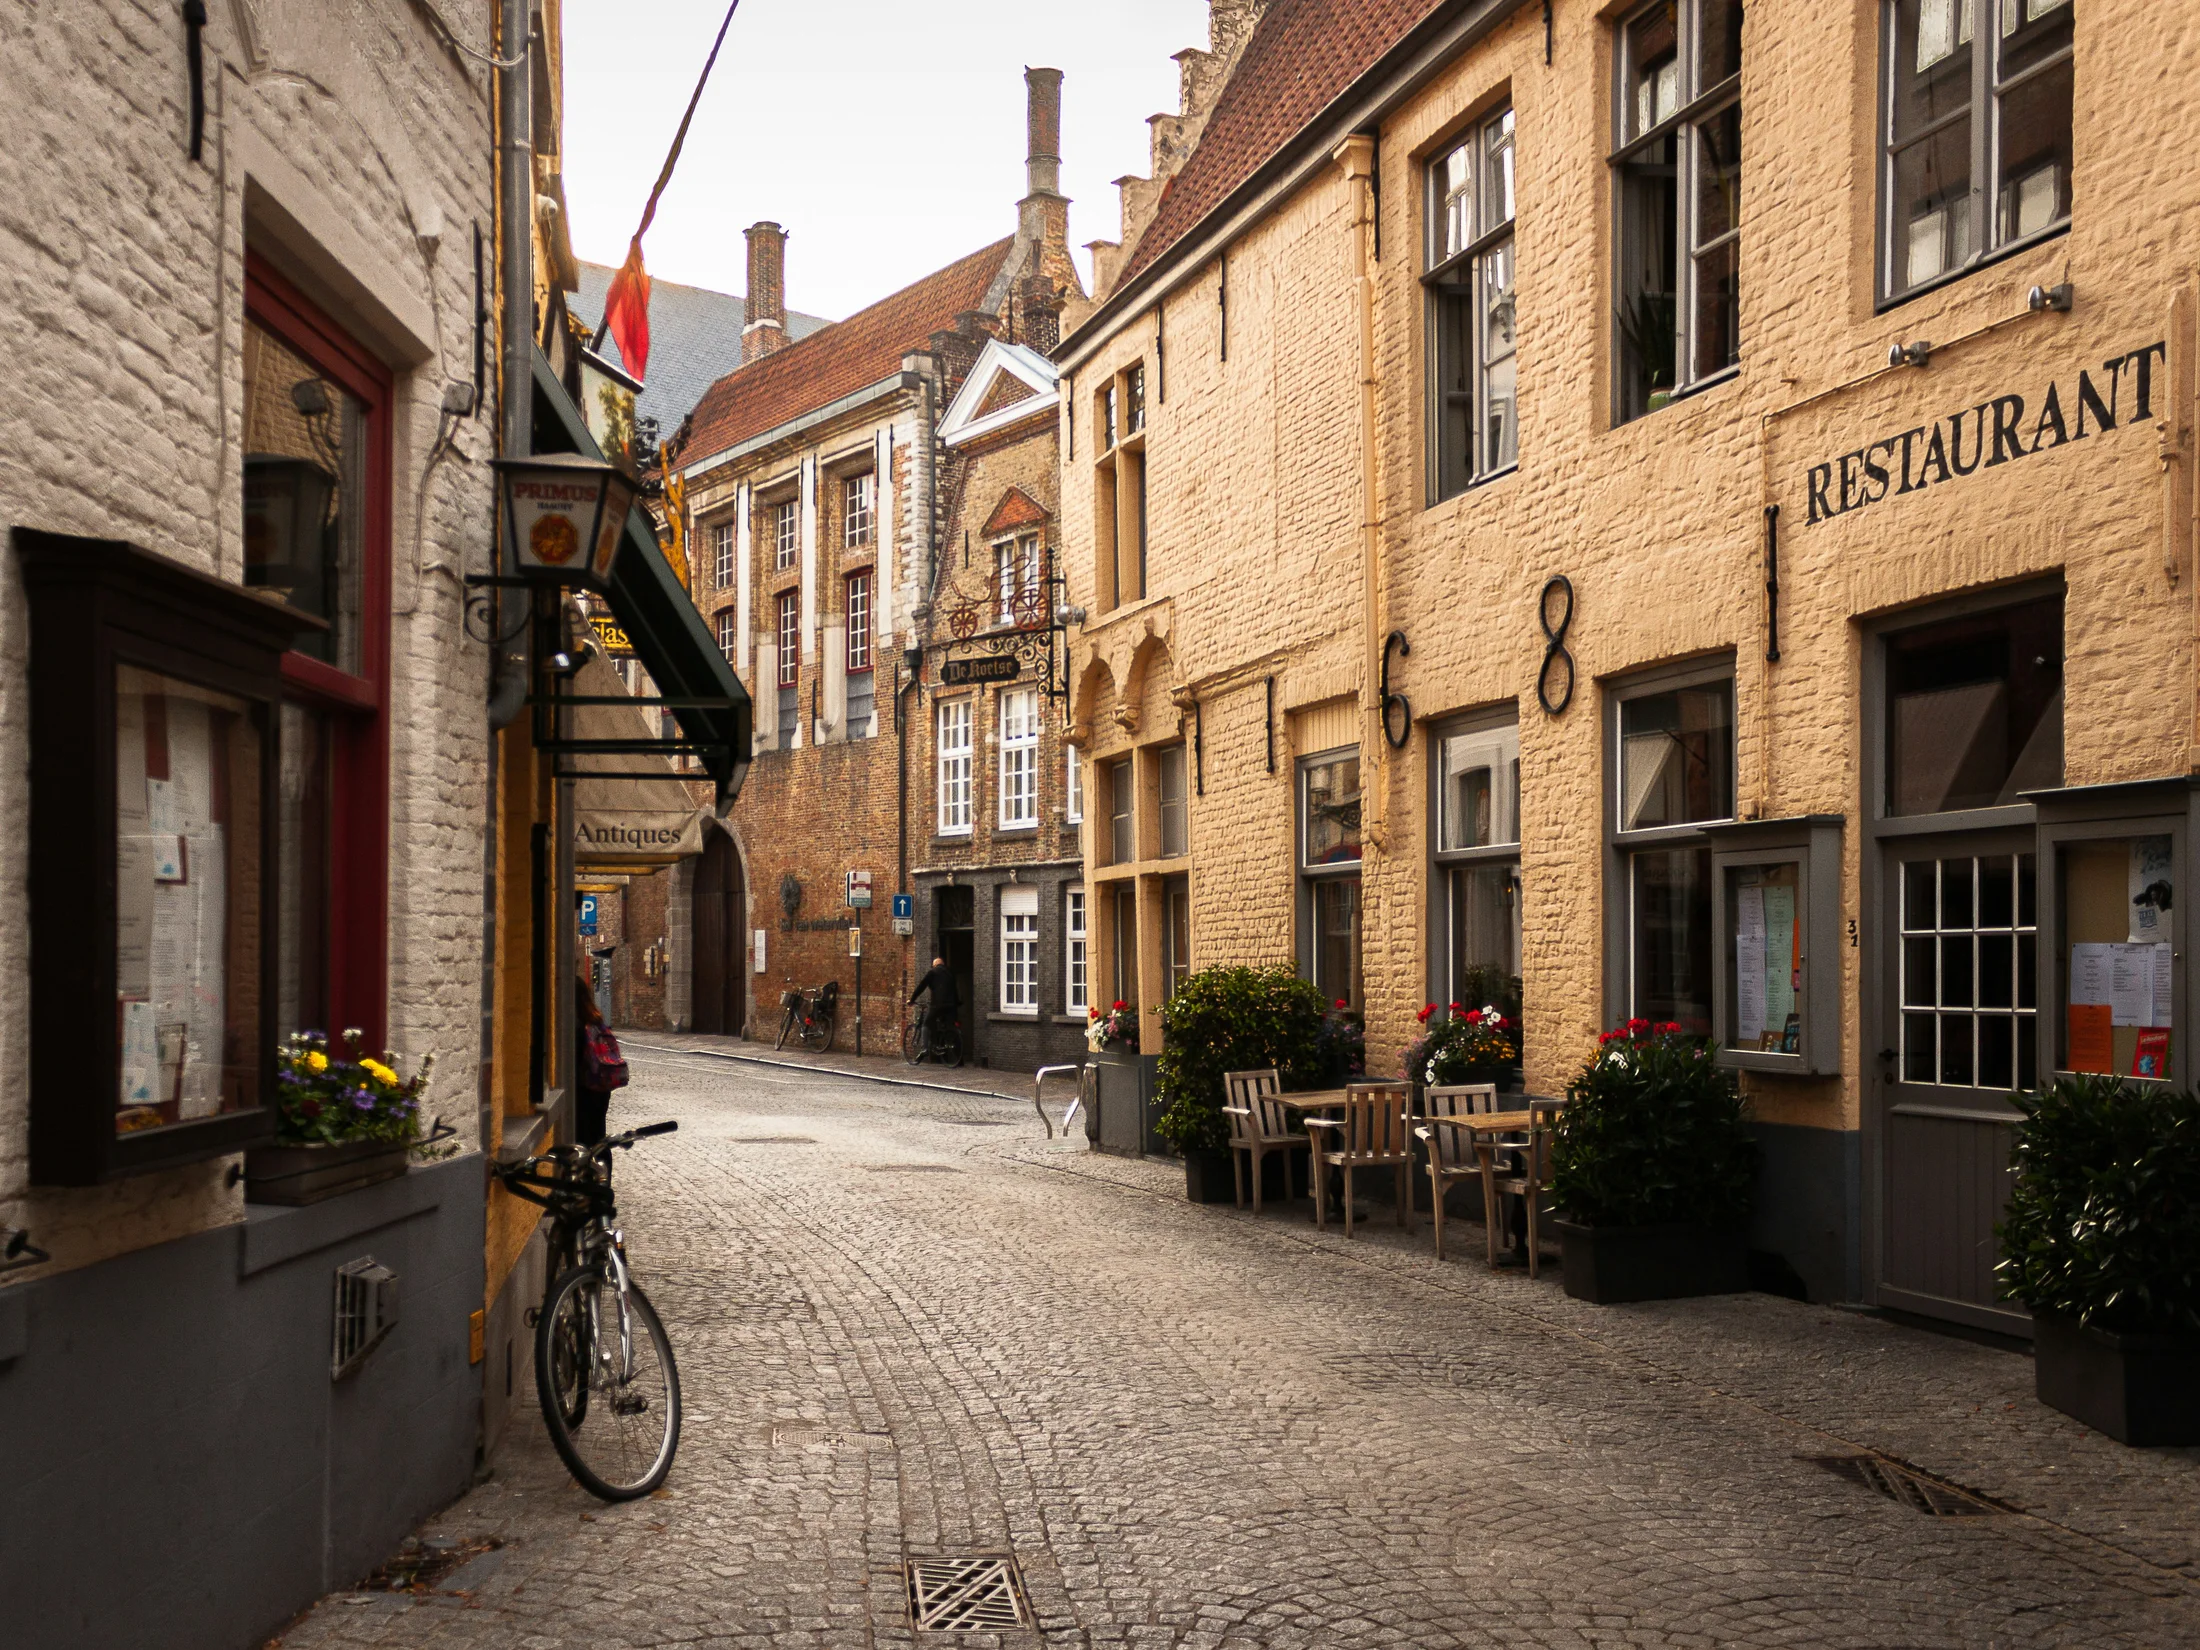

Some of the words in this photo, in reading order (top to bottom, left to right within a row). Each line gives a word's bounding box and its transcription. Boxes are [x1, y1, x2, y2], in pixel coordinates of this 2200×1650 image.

[1804, 340, 2167, 528] RESTAURANT
[513, 483, 599, 502] PRIMUS
[948, 662, 966, 682] De
[1381, 630, 1411, 749] 6
[1538, 573, 1575, 715] 8
[574, 822, 681, 849] Antiques
[581, 900, 595, 920] P
